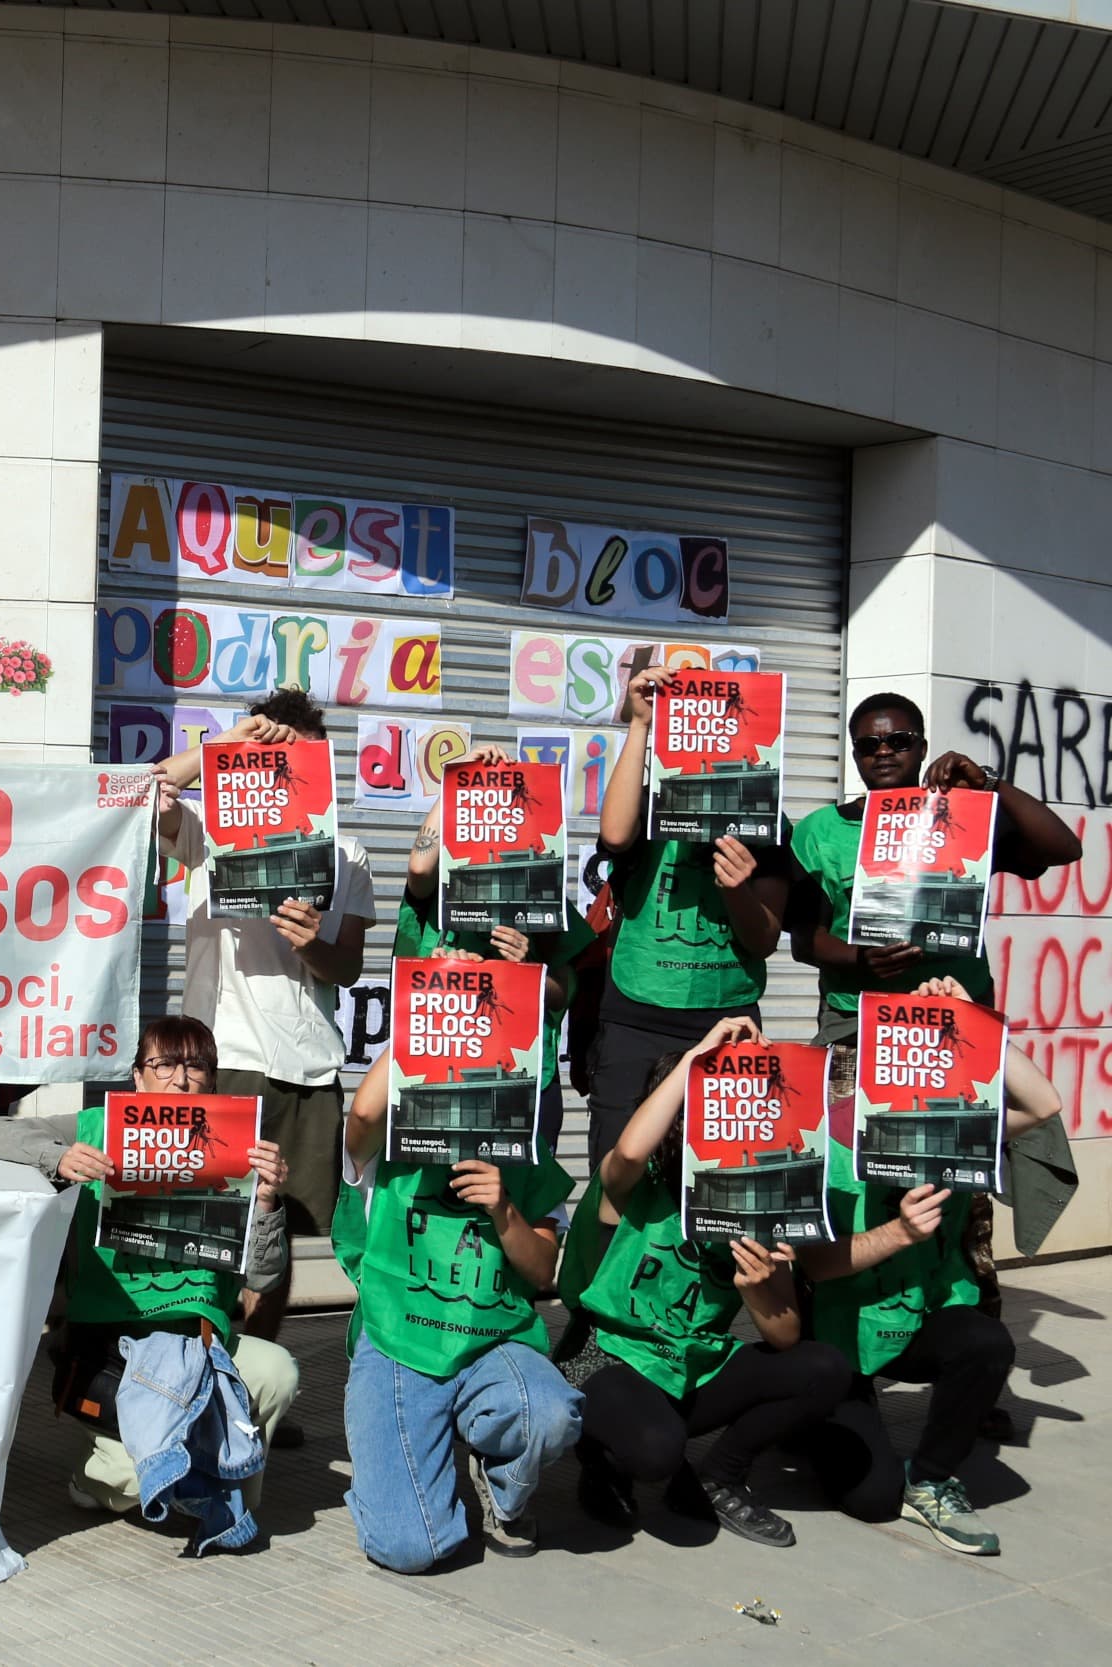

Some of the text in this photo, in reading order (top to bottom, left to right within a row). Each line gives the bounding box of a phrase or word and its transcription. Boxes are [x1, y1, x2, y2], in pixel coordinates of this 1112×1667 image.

[527, 530, 725, 609] bloc
[671, 681, 740, 697] SAREB
[670, 699, 726, 716] PROU
[669, 717, 738, 735] BLOCS
[668, 735, 730, 752] BUITS
[217, 752, 287, 770] SAREB
[111, 784, 150, 794] SAREB
[217, 772, 275, 790] PROU
[458, 772, 524, 787] SAREB
[97, 796, 149, 808] COSHAC
[219, 789, 288, 809] BLOCS
[456, 790, 512, 806] PROU
[882, 797, 949, 812] SARB
[219, 808, 282, 827] BUITS
[456, 808, 524, 824] BLOCS
[456, 825, 516, 842] BUITS
[411, 971, 493, 991] SAREB
[996, 937, 1112, 1034] LOC
[410, 993, 477, 1014] PROU
[410, 1014, 491, 1036] BLOCS
[878, 1005, 954, 1026] SAREB
[20, 1015, 118, 1059] llars
[877, 1025, 939, 1047] PROU
[409, 1036, 482, 1057] BUITS
[704, 1056, 780, 1074] SAREB
[876, 1046, 953, 1069] BLOCS
[875, 1066, 945, 1088] BUITS
[704, 1078, 768, 1098] PROU
[124, 1106, 205, 1125] SAREB
[704, 1100, 781, 1119] BLOCS
[123, 1128, 189, 1148] PROU
[704, 1121, 773, 1140] BUITS
[123, 1150, 204, 1169] BLOCS
[122, 1170, 194, 1183] BUITS
[409, 1254, 504, 1292] LLEID
